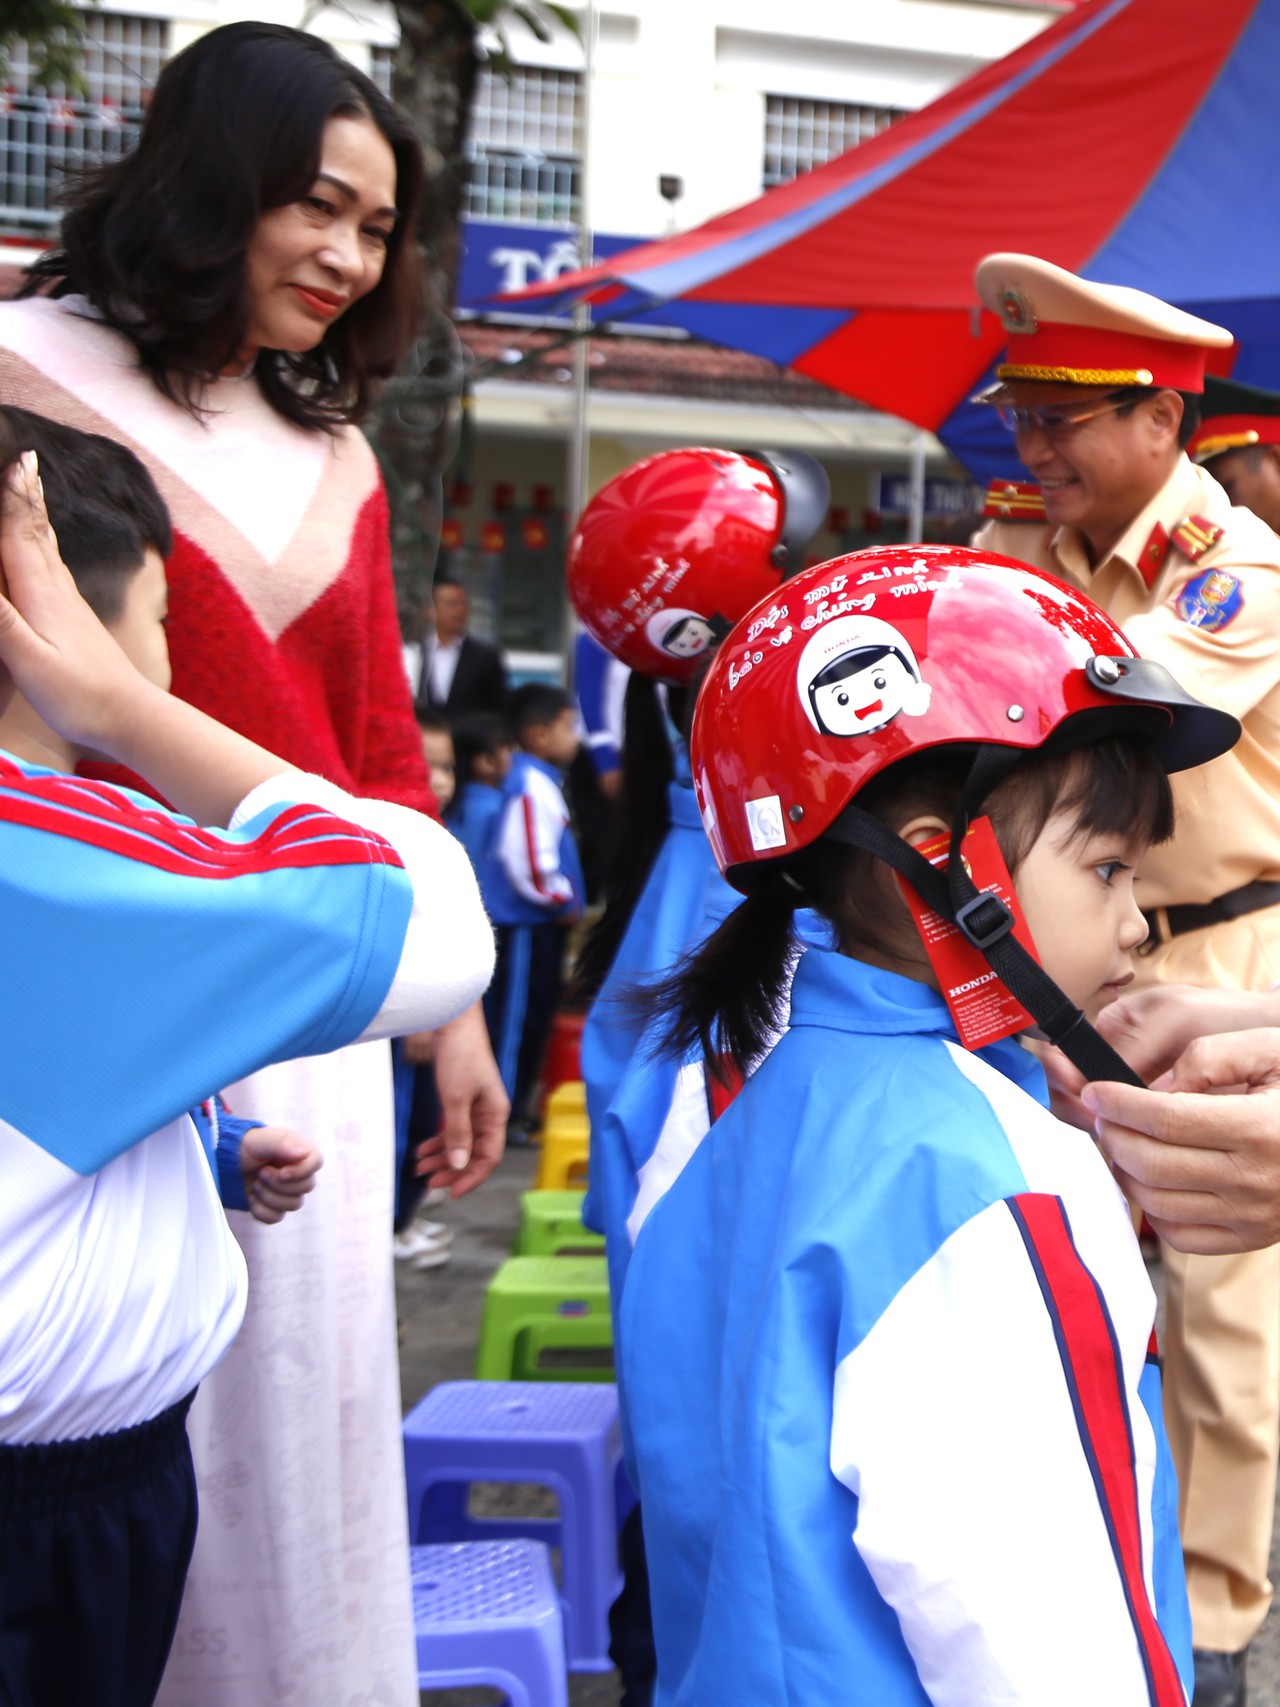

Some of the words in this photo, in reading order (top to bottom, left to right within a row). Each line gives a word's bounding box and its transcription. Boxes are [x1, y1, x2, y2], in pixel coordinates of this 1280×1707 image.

[747, 604, 788, 643] Đội
[803, 574, 848, 605] mũ
[856, 559, 929, 585] xinh
[728, 650, 763, 691] bảo
[770, 625, 793, 647] vệ
[801, 592, 876, 630] chúng
[890, 574, 964, 597] mình
[823, 635, 861, 654] HONDA
[948, 970, 998, 998] HONDA
